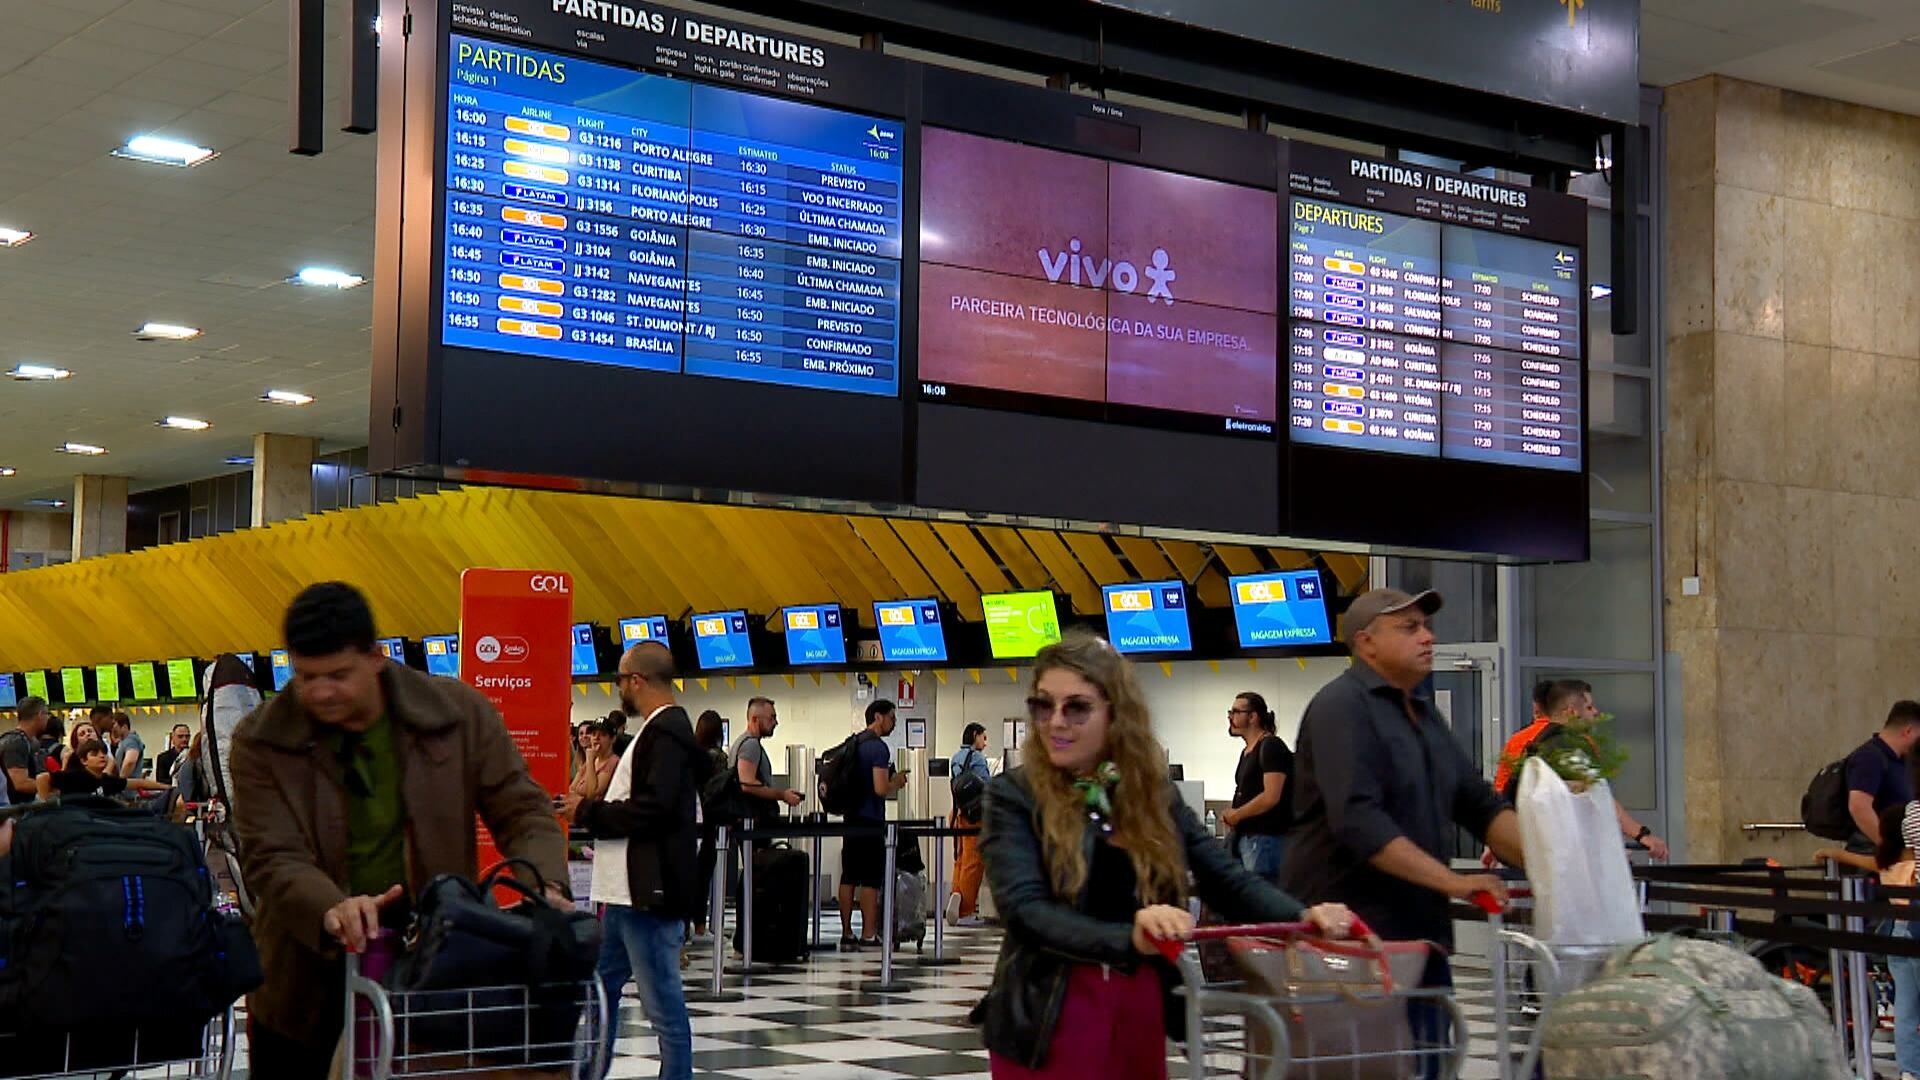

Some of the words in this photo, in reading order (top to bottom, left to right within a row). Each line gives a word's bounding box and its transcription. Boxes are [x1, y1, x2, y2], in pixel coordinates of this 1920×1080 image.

[453, 14, 489, 28] schedule
[489, 20, 532, 38] destination
[552, 0, 664, 34] PARTIDAS
[686, 20, 825, 68] DEPARTURES
[457, 68, 490, 87] Página
[459, 43, 566, 84] PARTIDAS
[454, 94, 478, 106] HORA
[522, 106, 552, 121] AIRLINE
[577, 116, 604, 130] FLIGHT
[631, 126, 648, 138] CITY
[739, 146, 778, 161] ESTIMATED
[831, 162, 857, 175] STATUS
[456, 109, 487, 125] 16:00
[579, 132, 594, 145] G3
[633, 142, 670, 159] PORTO
[671, 148, 713, 165] ALEGRE
[821, 174, 866, 191] PREVISTO
[455, 154, 485, 169] 16:25
[578, 176, 593, 189] G3
[631, 184, 719, 209] FLORIANÓPOLIS
[800, 209, 835, 226] ÚLTIMA
[837, 216, 886, 236] CHAMADA
[456, 132, 486, 148] 16:15
[579, 154, 594, 167] G3
[632, 164, 682, 182] CURITIBA
[803, 191, 824, 205] VOO
[827, 195, 883, 215] ENCERRADO
[1351, 159, 1422, 188] PARTIDAS
[1435, 176, 1527, 208] DEPARTURES
[453, 200, 483, 216] 16:35
[577, 220, 592, 233] G3
[630, 229, 677, 246] GOIÂNIA
[807, 255, 830, 269] EMB.
[833, 259, 876, 275] INICIADO
[454, 176, 484, 192] 16:30
[523, 190, 555, 201] LATAM
[576, 196, 585, 211] JJ
[631, 206, 669, 222] PORTO
[670, 213, 712, 229] ALEGRE
[808, 233, 831, 247] EMB.
[834, 237, 877, 253] INICIADO
[1295, 202, 1384, 234] DEPARTURES
[451, 245, 482, 261] 16:45
[520, 258, 553, 269] LATAM
[574, 264, 583, 278] JJ
[628, 272, 701, 292] NAVEGANTES
[806, 296, 829, 310] EMB.
[832, 300, 875, 316] INICIADO
[452, 223, 482, 239] 16:40
[522, 236, 554, 247] LATAM
[575, 241, 584, 256] JJ
[629, 250, 676, 268] GOIÂNIA
[797, 272, 834, 290] ÚLTIMA
[835, 280, 884, 298] CHAMADA
[1038, 238, 1138, 294] vivo
[450, 290, 480, 306] 16:50
[572, 307, 588, 320] G3
[626, 315, 643, 328] ST.
[644, 317, 696, 335] DUMONT
[705, 326, 716, 340] RJ
[806, 338, 871, 356] CONFIRMADO
[451, 268, 481, 284] 16:50
[573, 286, 588, 299] G3
[627, 294, 700, 314] NAVEGANTES
[817, 317, 862, 334] PREVISTO
[951, 296, 1025, 321] PARCEIRA
[1029, 306, 1131, 335] TECNOLÓGICA
[1134, 322, 1153, 338] DA
[1156, 324, 1184, 342] SUA
[449, 312, 479, 328] 16:55
[571, 329, 587, 342] G3
[626, 335, 674, 353] BRASÍLIA
[803, 358, 827, 372] EMB.
[829, 359, 874, 377] PRÓXIMO
[922, 384, 946, 397] 16:08
[530, 575, 569, 593] GOL
[475, 674, 532, 691] Serviços
